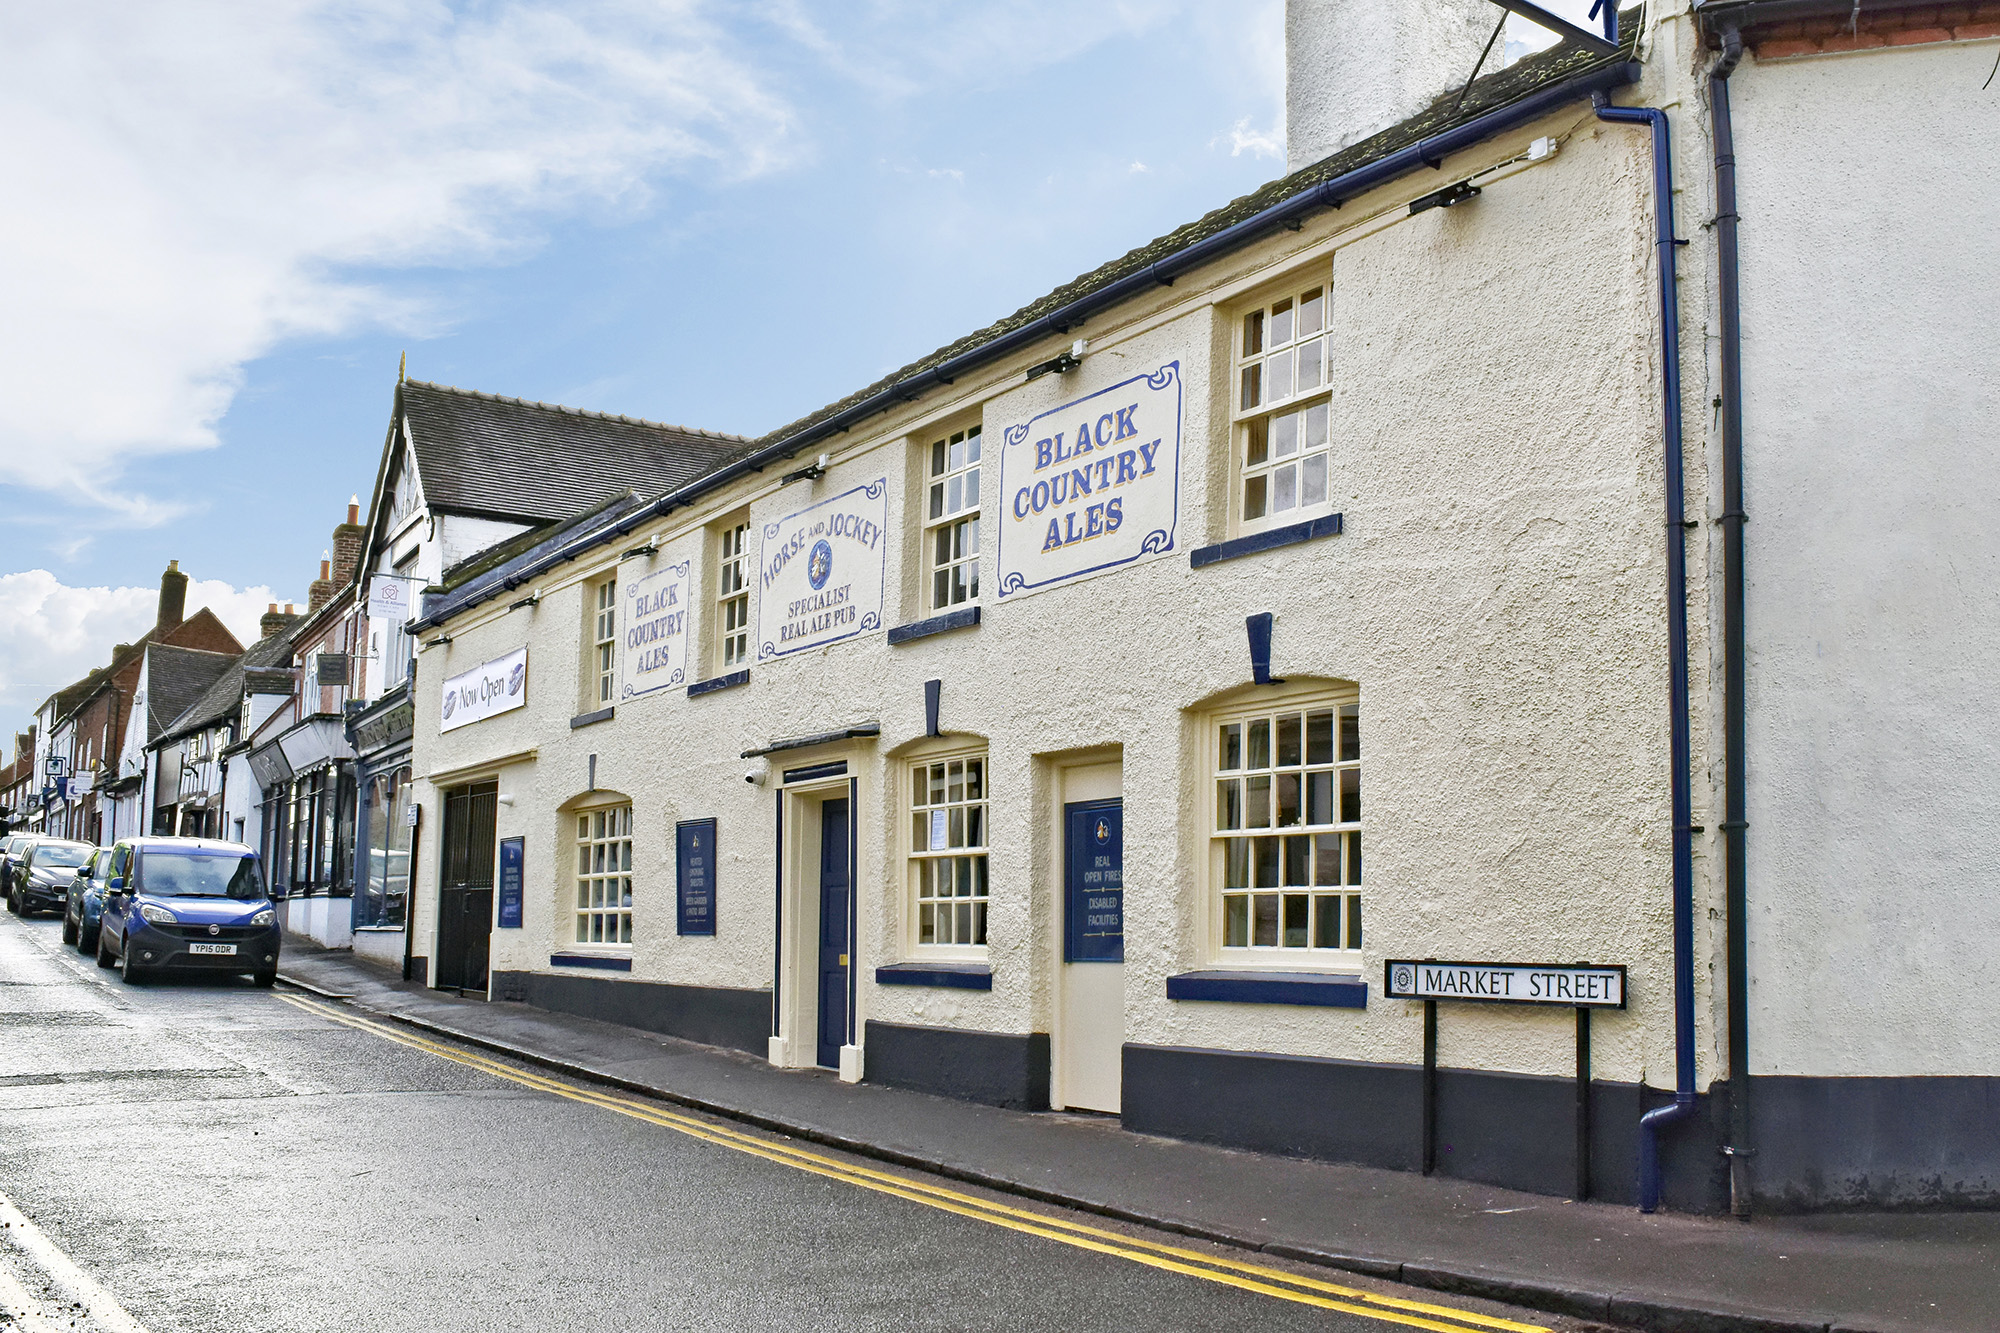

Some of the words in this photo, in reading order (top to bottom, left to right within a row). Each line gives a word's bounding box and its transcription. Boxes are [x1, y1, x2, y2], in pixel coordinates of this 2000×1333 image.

[1034, 403, 1139, 474] BLACK
[1013, 438, 1162, 522] COUNTRY
[1041, 496, 1124, 555] ALES
[763, 527, 805, 590] HORSE
[808, 521, 825, 539] AND
[826, 513, 883, 551] JOCKEY
[635, 583, 679, 619] BLACK
[788, 584, 852, 619] SPECIALIST
[627, 610, 685, 651] COUNTRY
[780, 618, 808, 644] REAL
[808, 610, 832, 632] ALE
[834, 605, 856, 627] PUB
[636, 645, 670, 676] ALES
[459, 685, 479, 710] Now
[481, 676, 505, 707] Open
[1084, 871, 1102, 884] OPEN
[1104, 870, 1122, 882] FIRES
[1095, 856, 1111, 868] REAL
[1088, 897, 1118, 910] DISABLED
[1088, 913, 1119, 927] FACILITIES
[195, 945, 213, 953] YP15
[215, 945, 232, 953] ODR
[1425, 969, 1515, 995] MARKET
[1530, 972, 1615, 999] STREET
